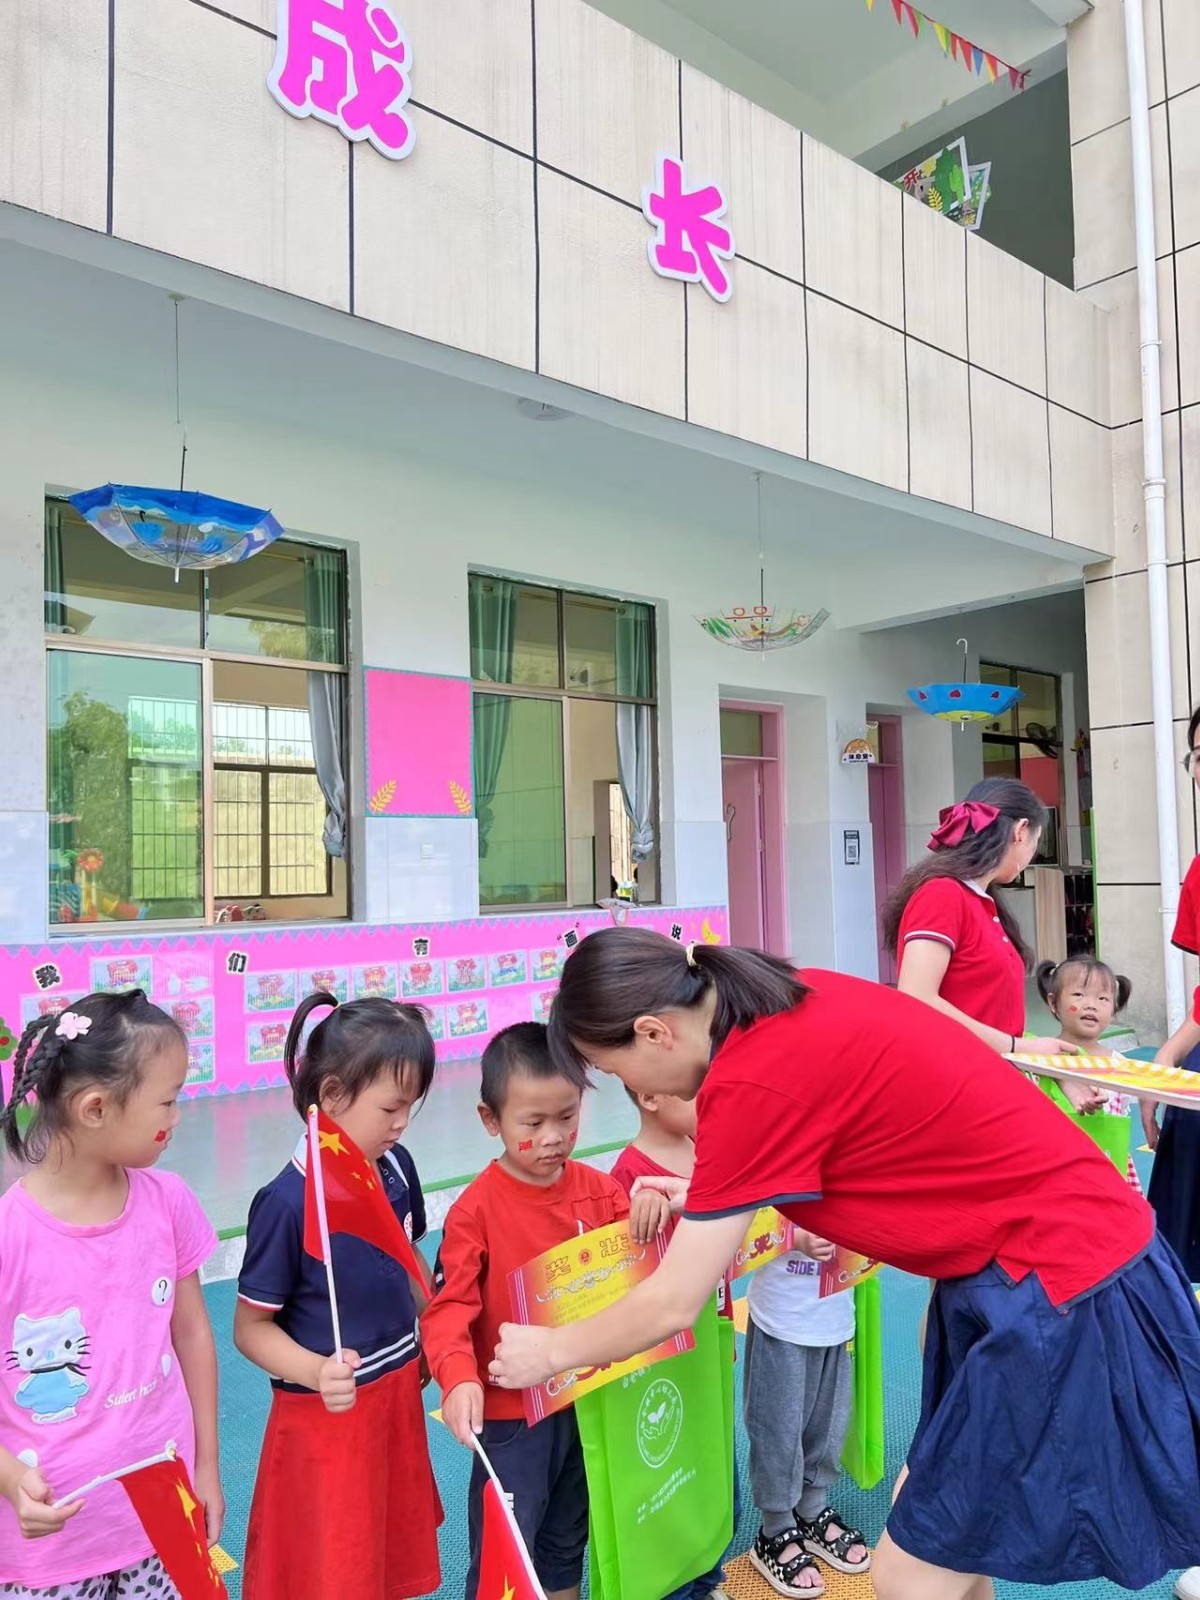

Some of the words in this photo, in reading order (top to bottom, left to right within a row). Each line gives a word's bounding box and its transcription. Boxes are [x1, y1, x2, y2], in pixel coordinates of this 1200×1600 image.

[275, 0, 410, 151] 成
[647, 156, 732, 297] 长
[228, 952, 247, 973] 们
[671, 924, 682, 941] 说
